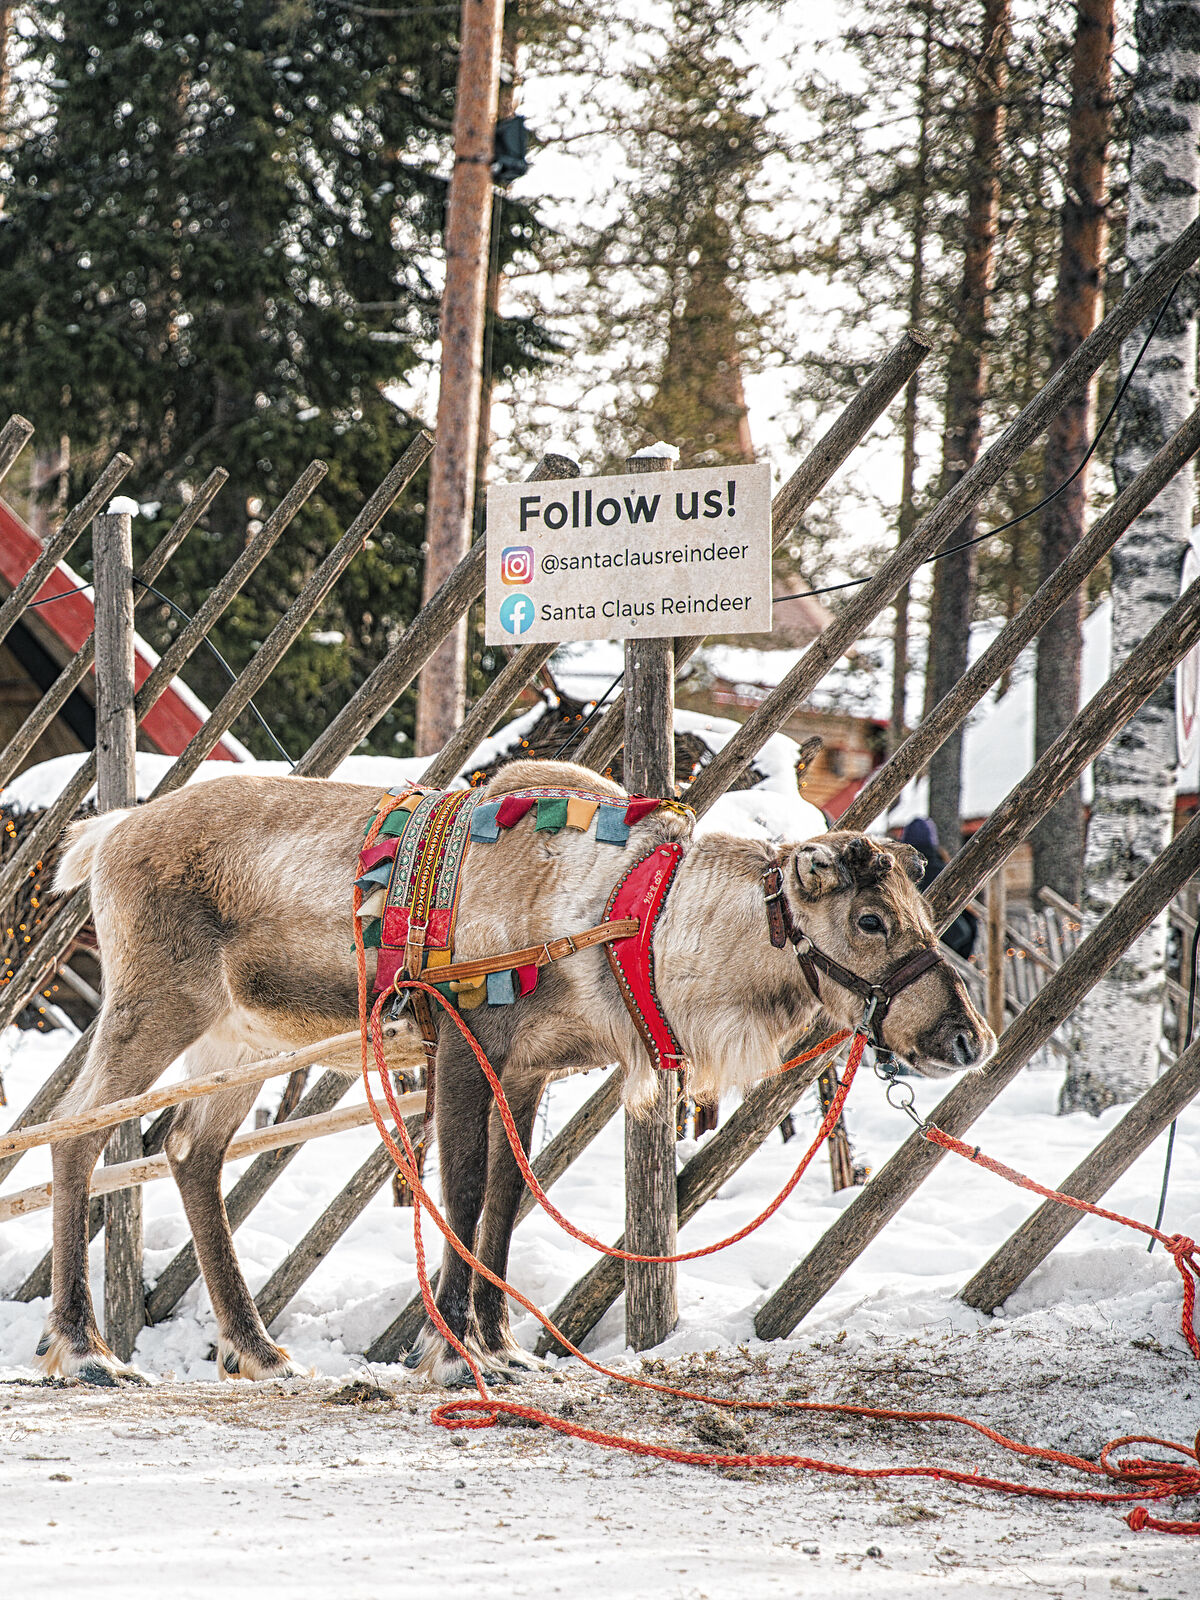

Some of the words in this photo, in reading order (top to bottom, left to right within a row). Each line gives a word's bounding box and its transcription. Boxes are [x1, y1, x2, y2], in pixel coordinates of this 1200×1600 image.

[519, 489, 661, 532] Follow
[675, 480, 736, 521] us!
[541, 543, 749, 575] @santaclausreindeer
[540, 603, 596, 621] Santa
[602, 599, 655, 618] Claus
[661, 593, 752, 615] Reindeer
